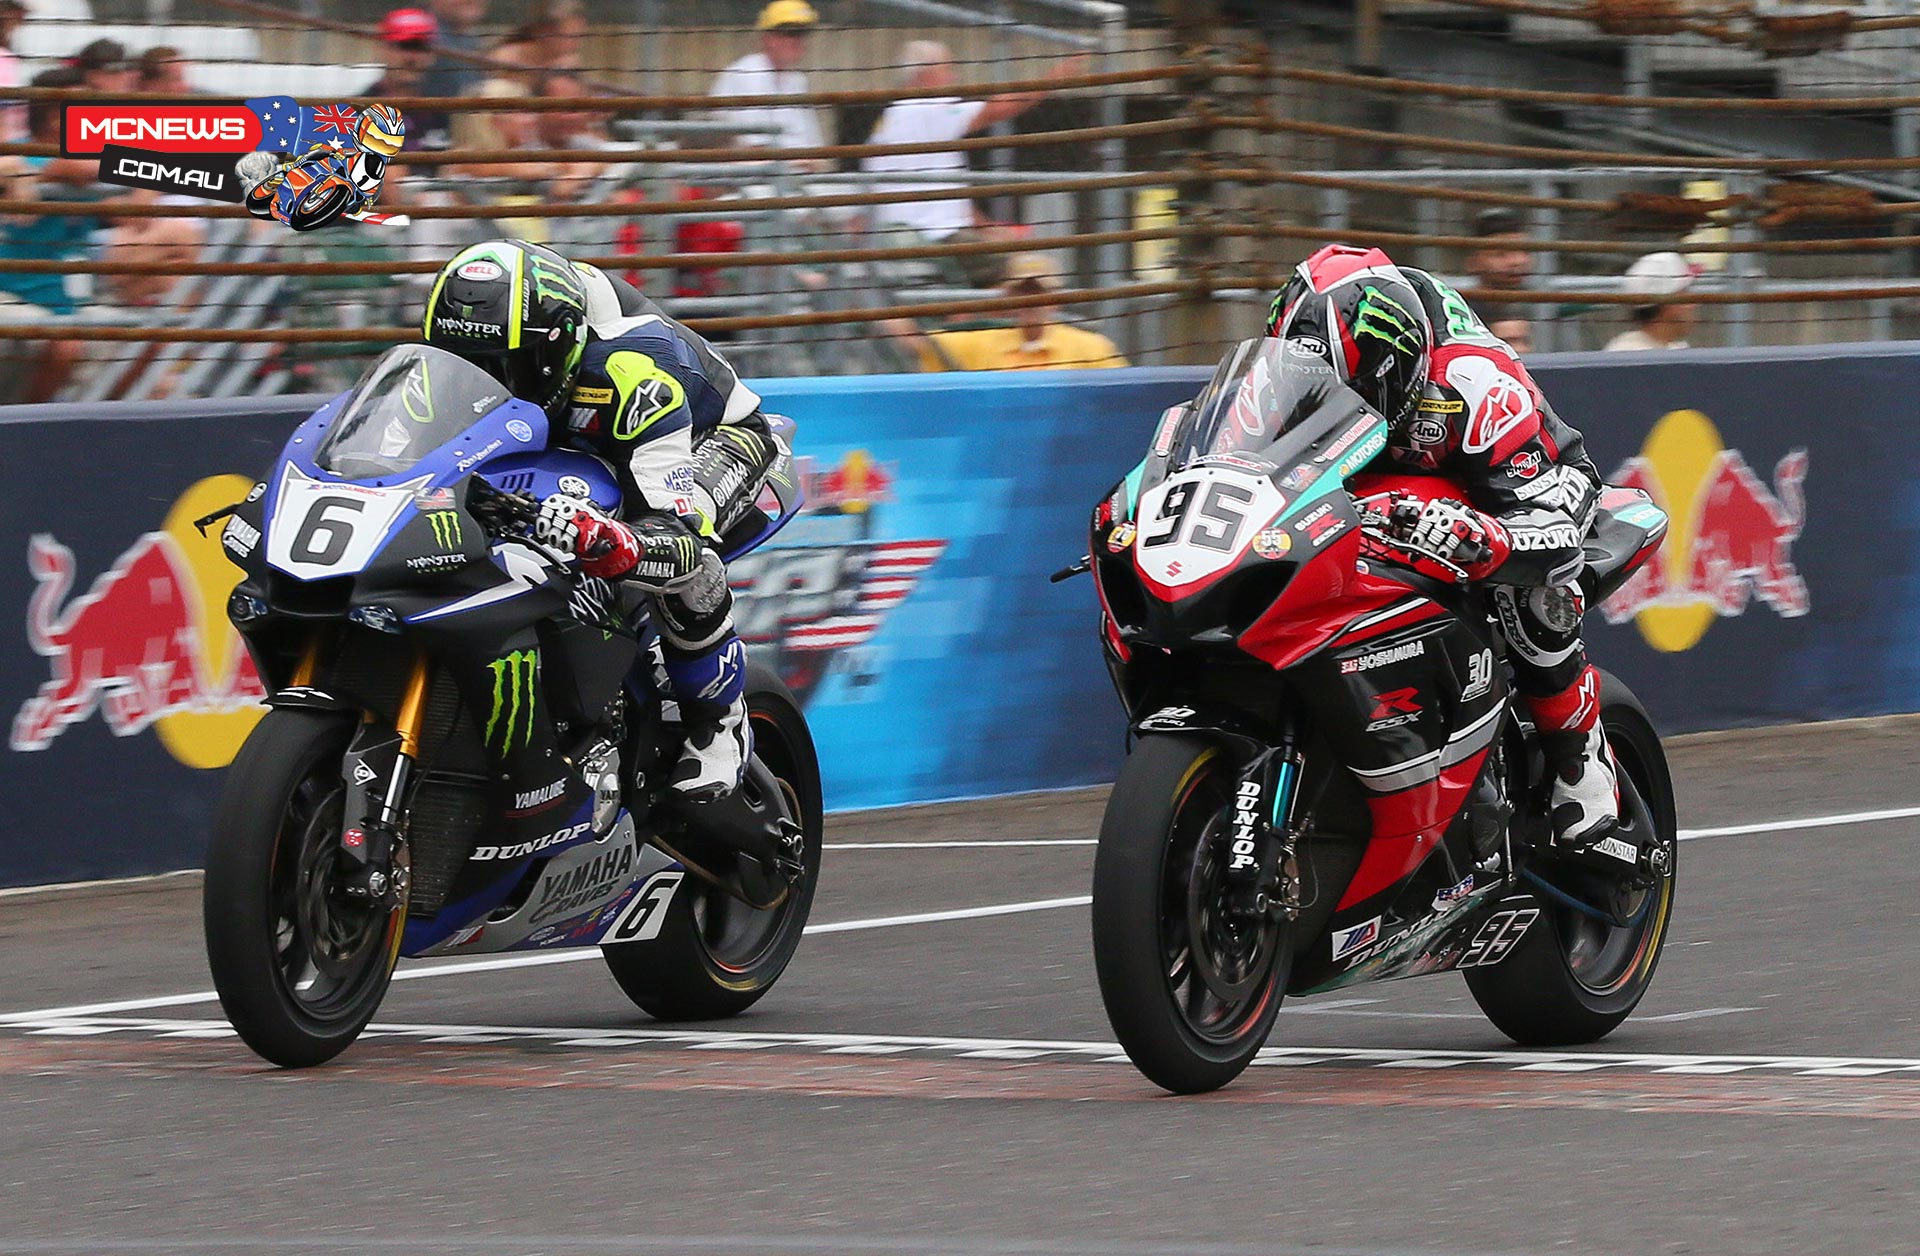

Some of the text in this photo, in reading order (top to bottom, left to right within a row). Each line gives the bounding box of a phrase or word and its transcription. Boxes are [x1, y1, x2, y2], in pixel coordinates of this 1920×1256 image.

[465, 264, 494, 275] BELL
[436, 316, 503, 337] MONSTER
[1421, 401, 1462, 410] DUNLOP
[1414, 421, 1441, 438] Arai
[1345, 431, 1388, 471] MOTOREX
[289, 495, 366, 566] 6
[1142, 480, 1257, 554] 95
[1294, 503, 1334, 531] SUZUKI
[406, 552, 468, 569] MONSTER
[635, 560, 676, 579] YAMAHA
[1357, 639, 1426, 672] YOSHIMURA
[514, 776, 569, 810] YAMALUBE
[468, 821, 592, 862] DUNLOP
[1228, 780, 1262, 870] DUNLOP
[542, 843, 634, 901] YAMAHA
[614, 877, 681, 940] 6
